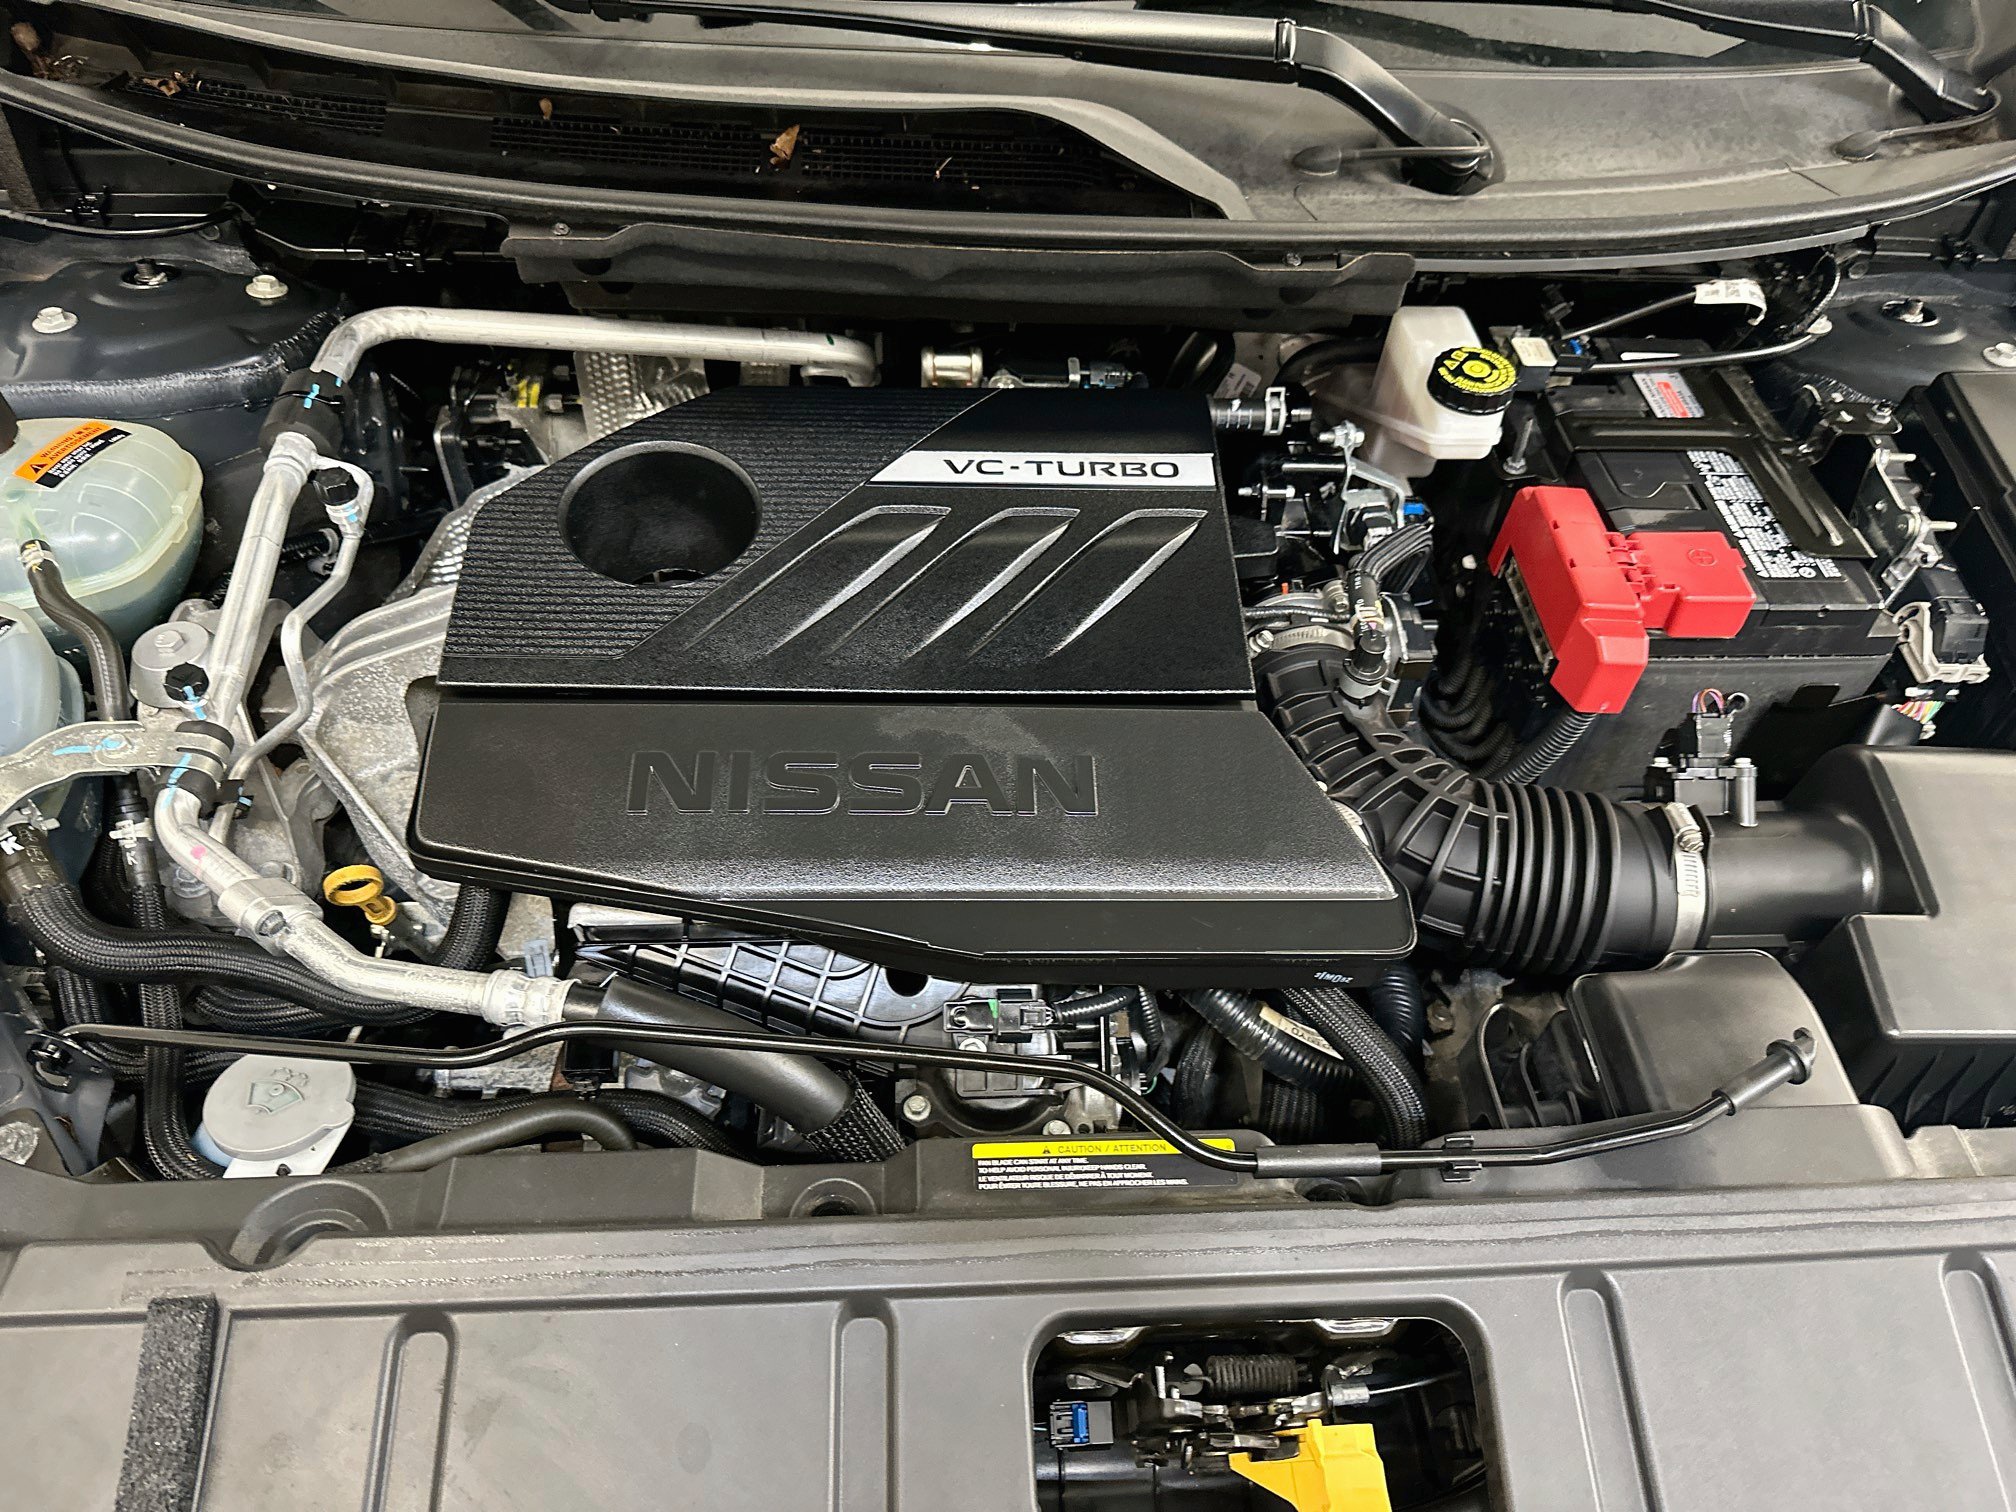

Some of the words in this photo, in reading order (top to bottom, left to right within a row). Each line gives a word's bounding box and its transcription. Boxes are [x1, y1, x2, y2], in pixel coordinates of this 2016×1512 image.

[943, 459, 1180, 478] VC-TURBO
[626, 750, 1099, 816] NISSAN
[1057, 1145, 1102, 1154] CAUTION
[1113, 1143, 1167, 1152] ATTENTION
